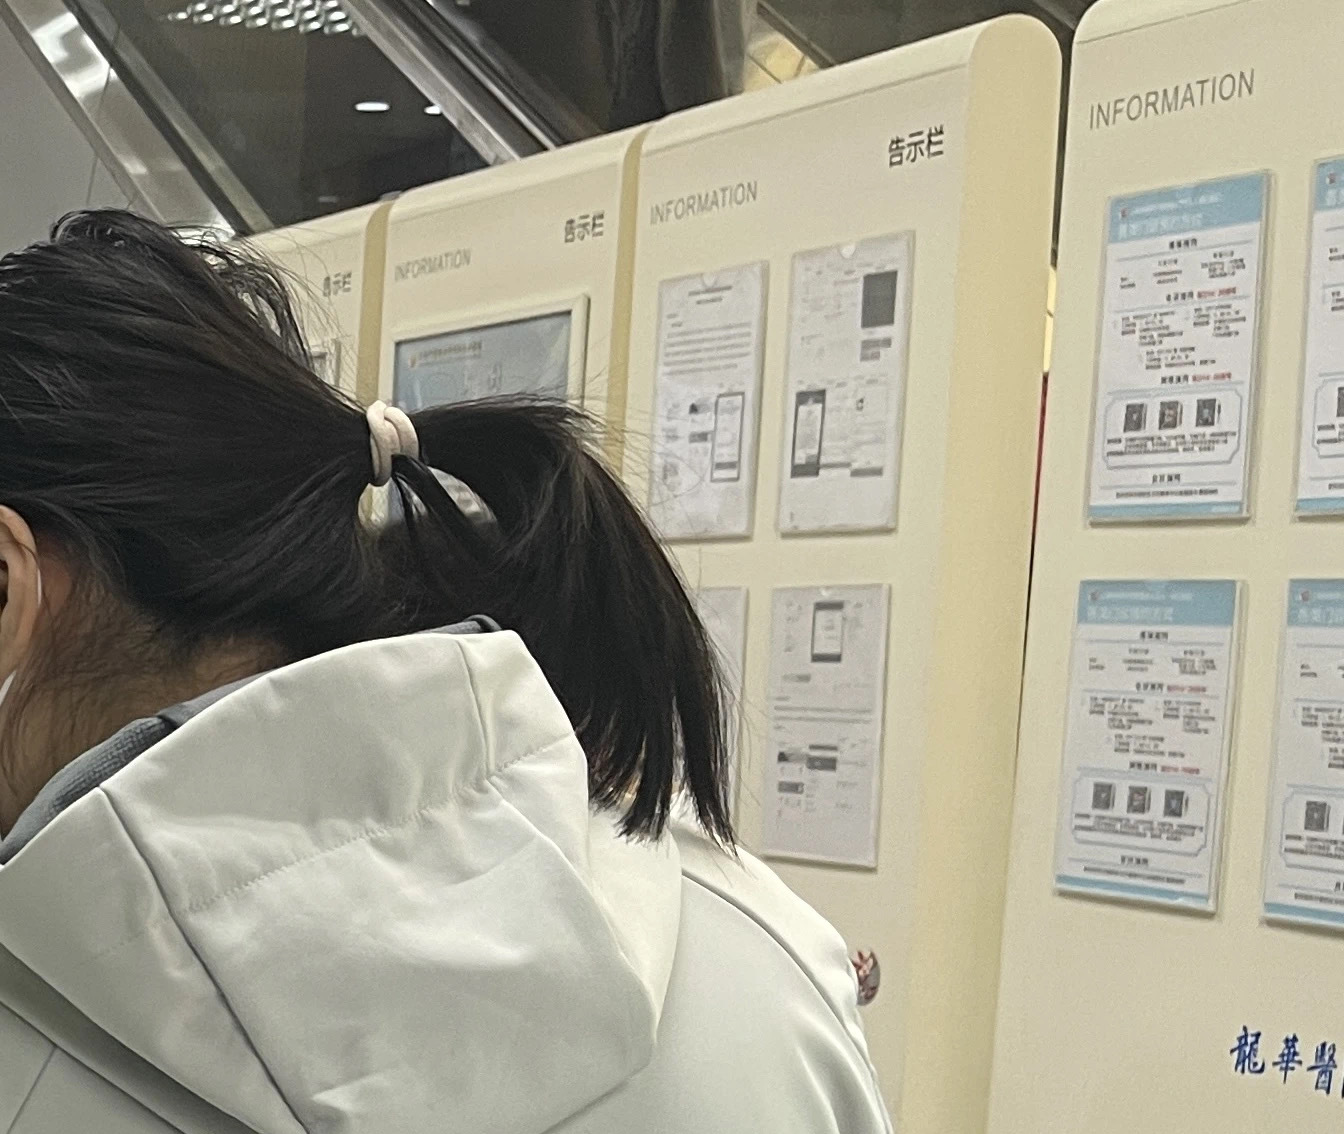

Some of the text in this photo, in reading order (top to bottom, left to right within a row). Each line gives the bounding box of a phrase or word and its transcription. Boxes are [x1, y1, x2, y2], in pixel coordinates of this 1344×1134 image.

[1089, 67, 1255, 131] INFORMATION
[888, 124, 945, 169] 告示栏
[649, 181, 758, 226] INFORMATION
[564, 210, 605, 244] 告示栏
[394, 249, 472, 282] INFORMATION
[1229, 1024, 1344, 1099] 龍華醫
